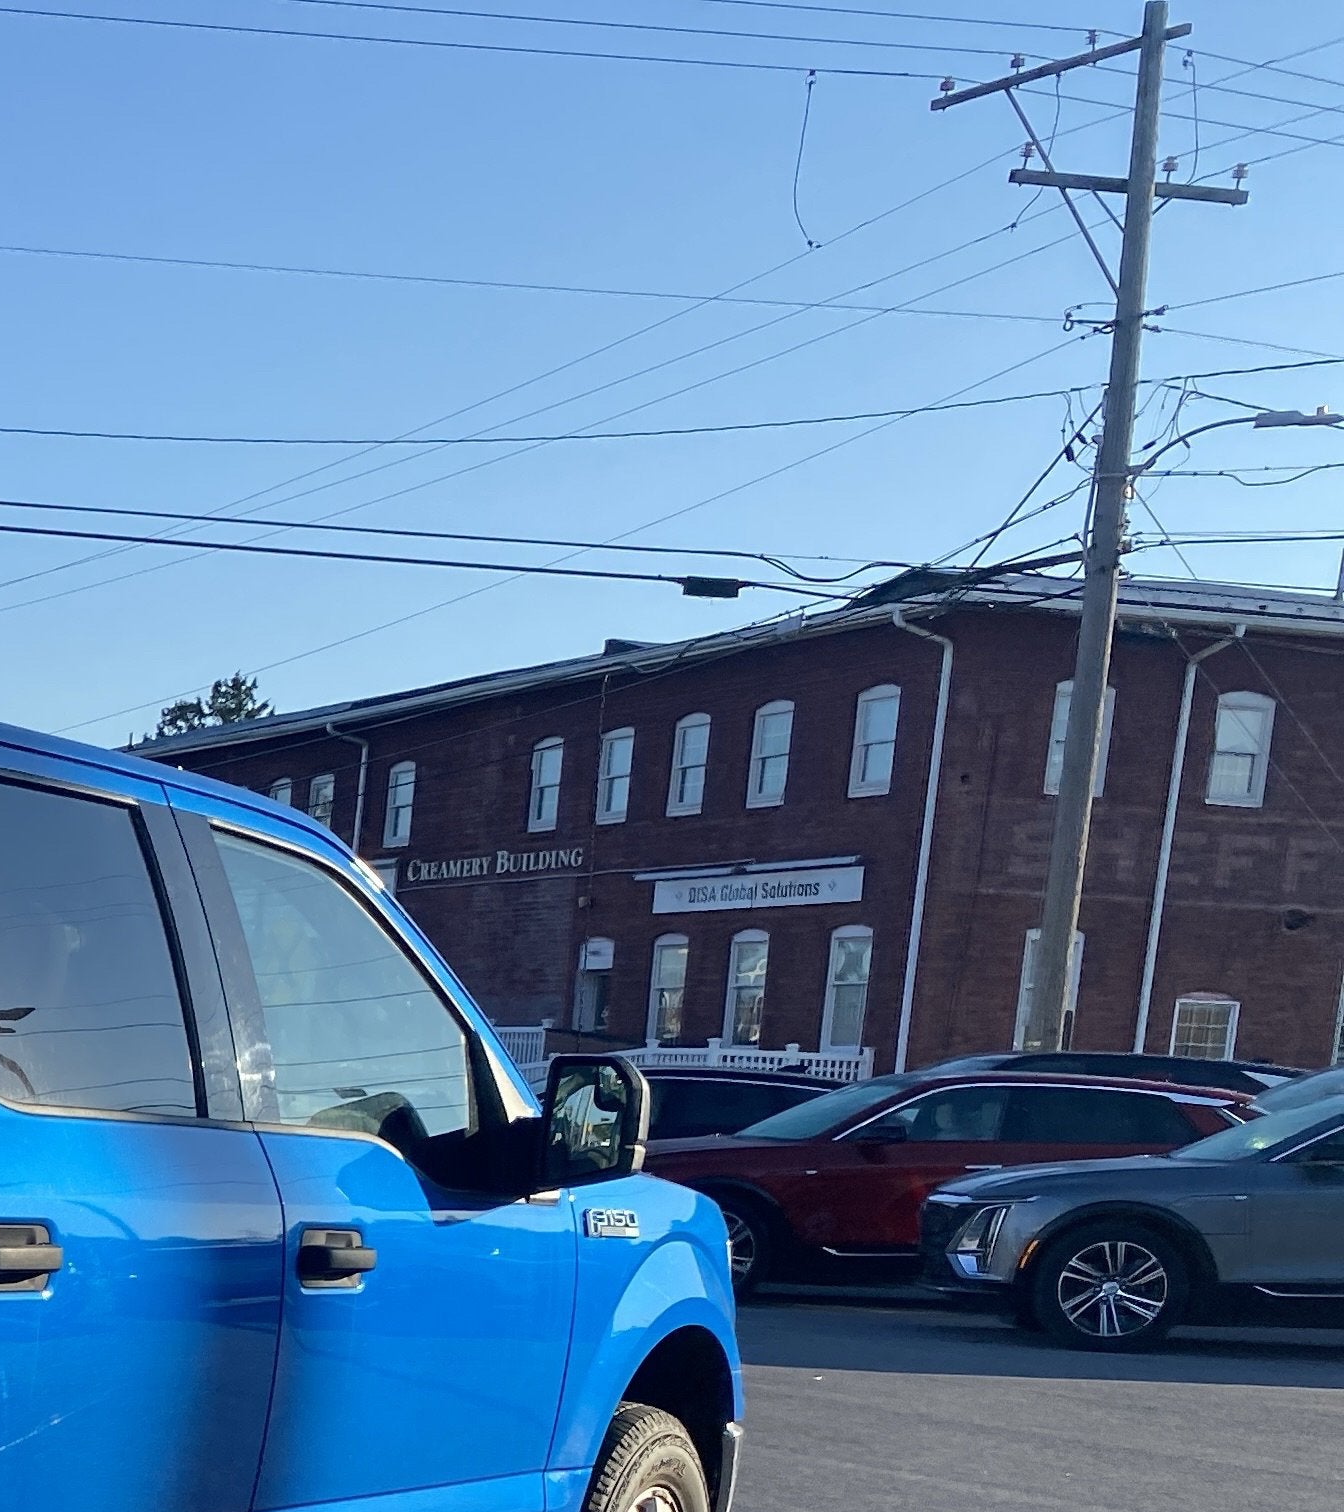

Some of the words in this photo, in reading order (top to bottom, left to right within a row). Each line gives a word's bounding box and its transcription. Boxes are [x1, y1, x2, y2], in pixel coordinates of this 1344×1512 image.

[407, 856, 492, 881] CREAMERY
[496, 848, 584, 874] BUILDING
[720, 883, 758, 902] Global
[762, 881, 821, 899] Solutions
